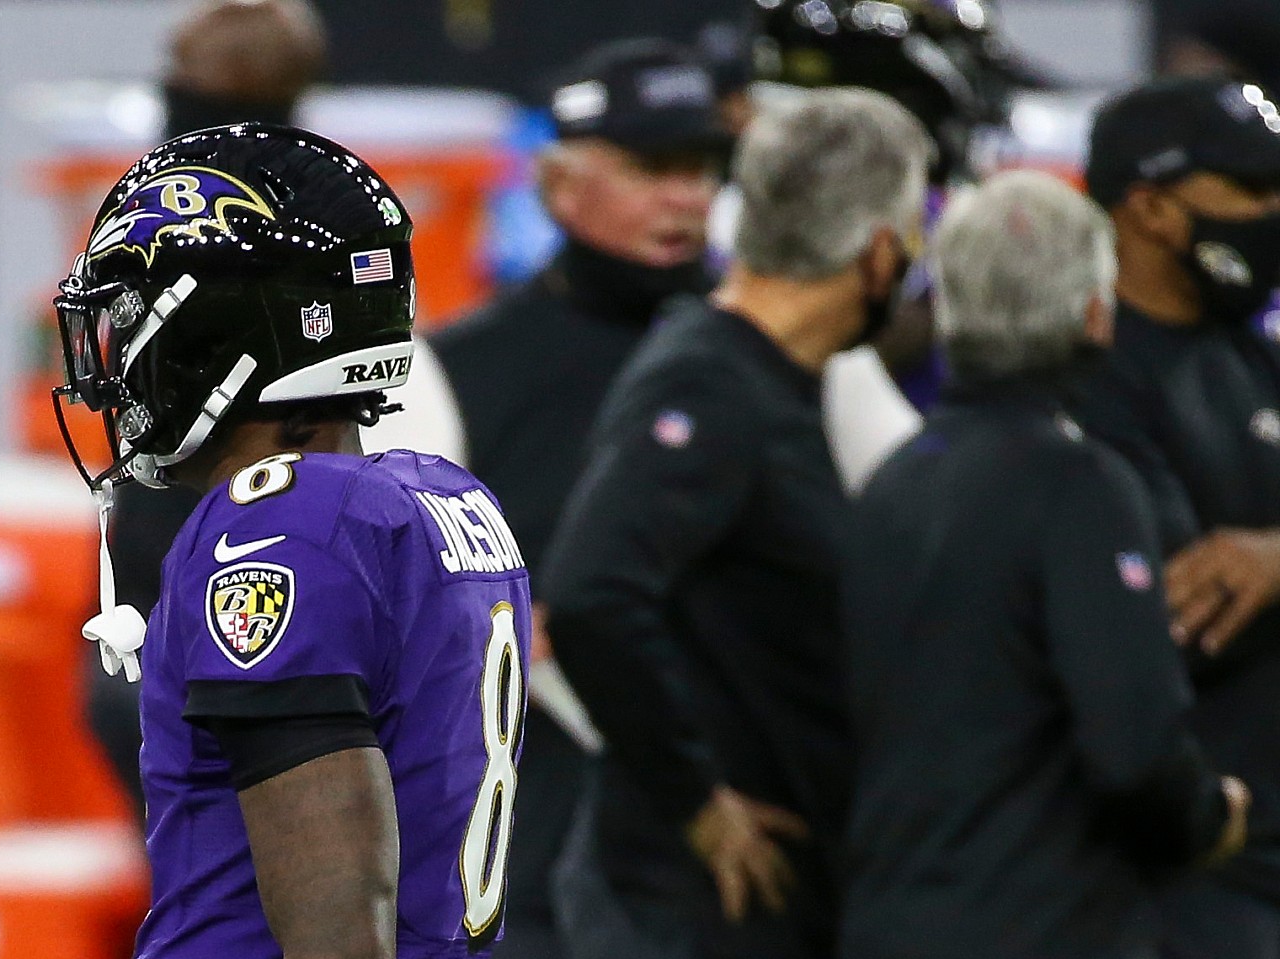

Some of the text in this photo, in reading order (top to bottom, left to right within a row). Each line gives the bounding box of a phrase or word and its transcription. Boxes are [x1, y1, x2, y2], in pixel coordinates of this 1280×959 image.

[148, 174, 207, 216] B
[307, 318, 330, 336] NFL
[216, 571, 283, 589] RAVENS
[461, 601, 522, 938] 8
